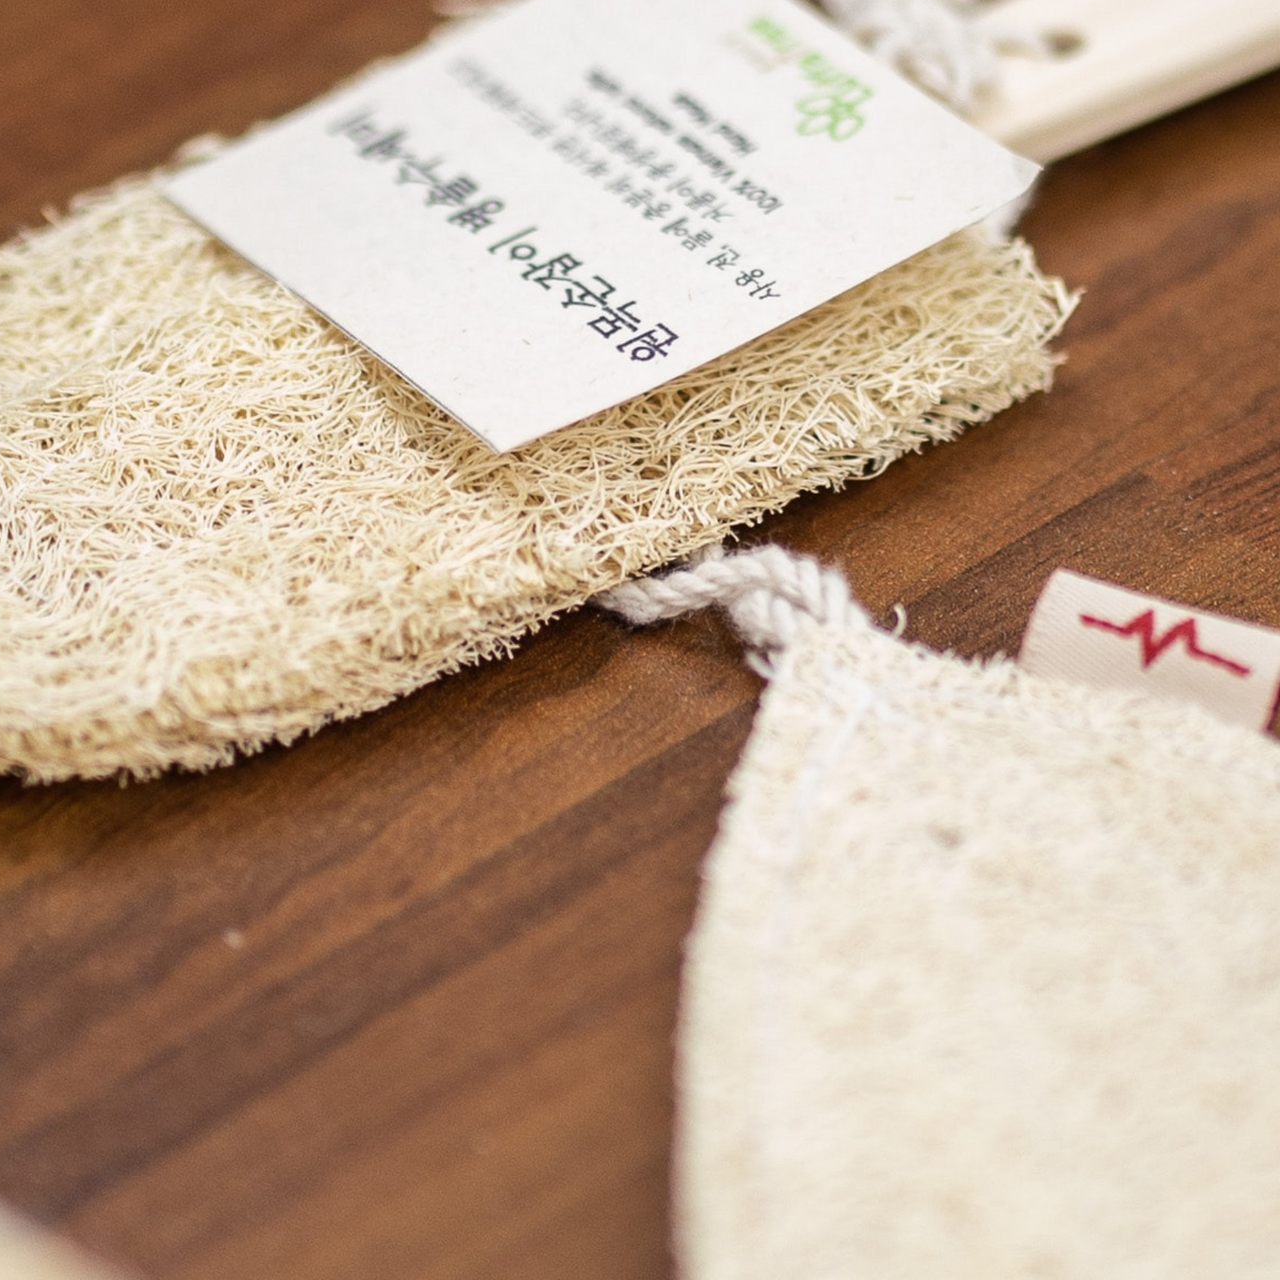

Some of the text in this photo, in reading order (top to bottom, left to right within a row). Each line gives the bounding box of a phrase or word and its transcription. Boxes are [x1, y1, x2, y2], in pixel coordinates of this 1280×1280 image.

[603, 175, 674, 222] 충분히
[664, 176, 734, 224] 거품이
[730, 178, 784, 215] 100%
[327, 109, 682, 364] 원목손잡이 병솔수세미
[659, 216, 715, 253] 물에
[732, 267, 783, 302] 사용
